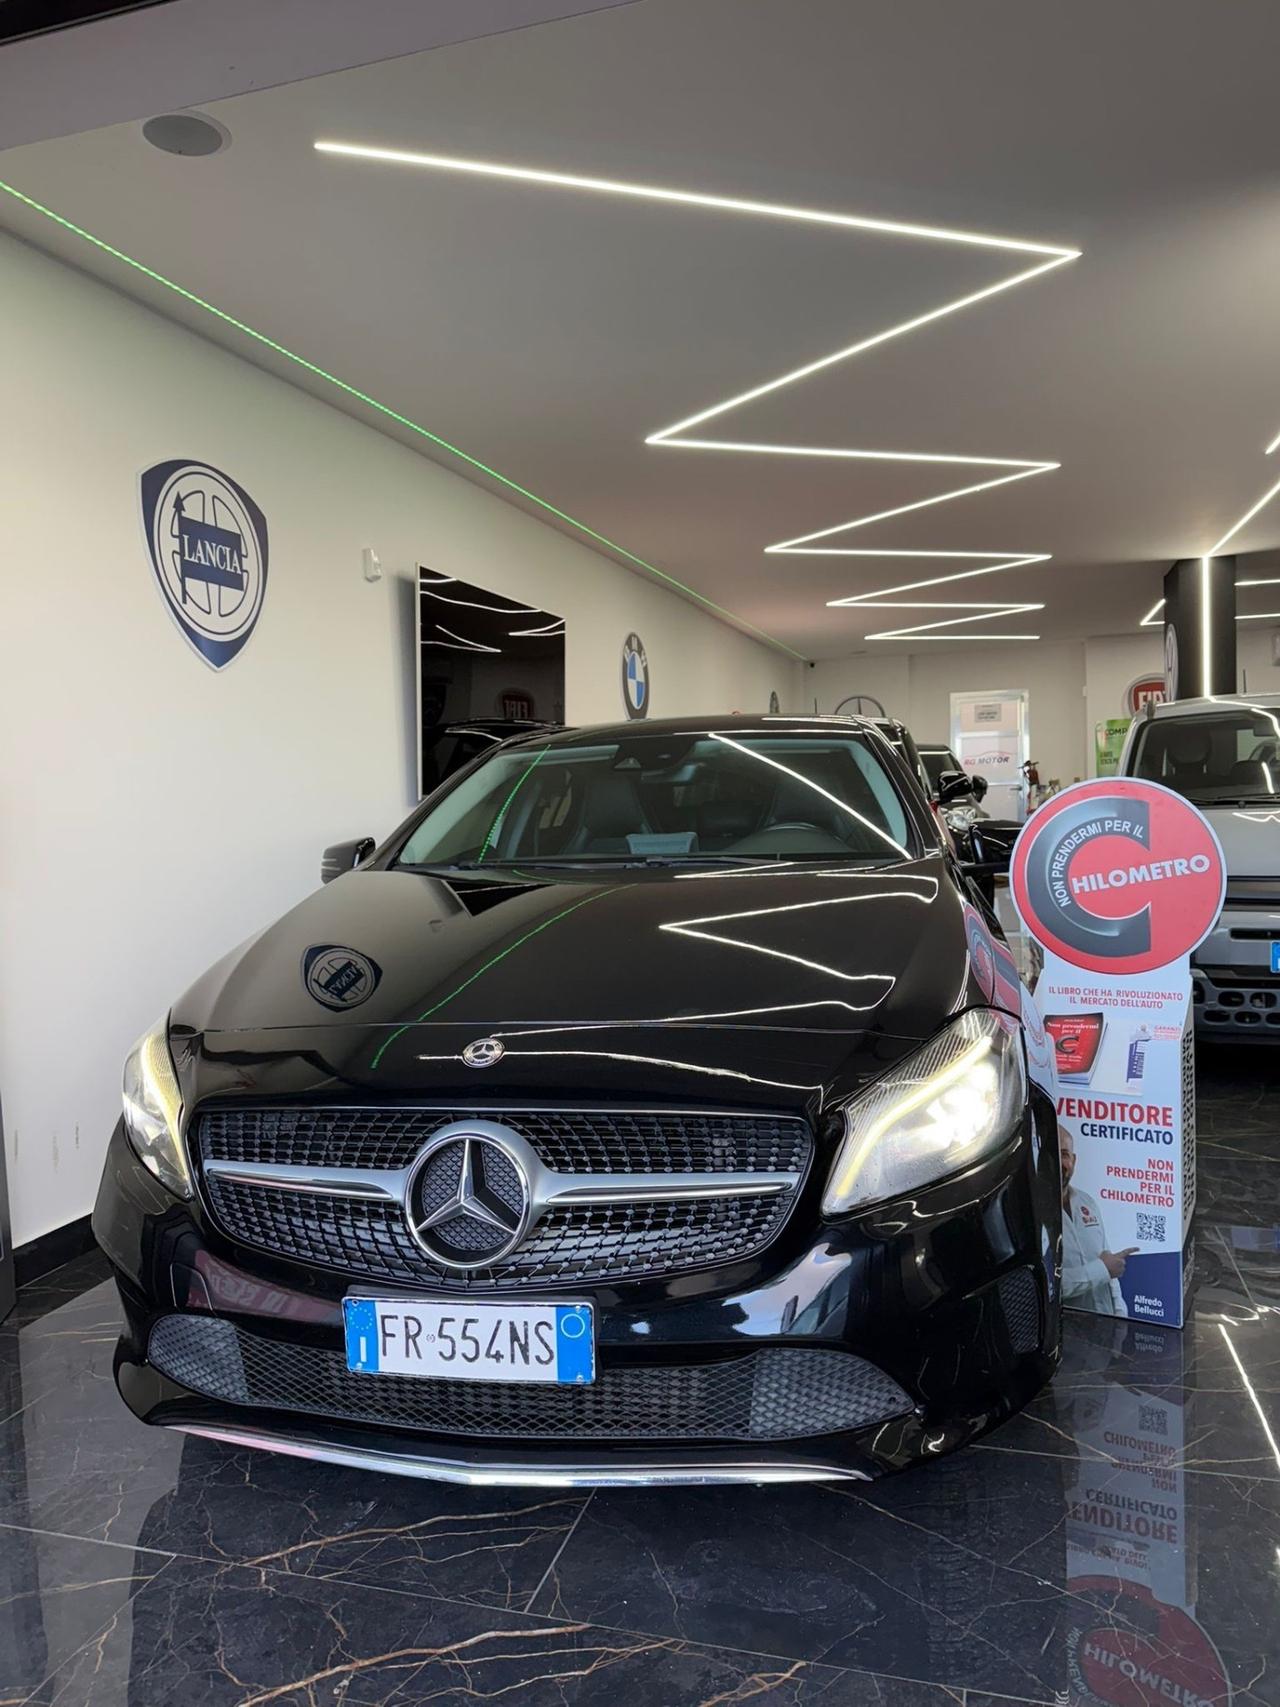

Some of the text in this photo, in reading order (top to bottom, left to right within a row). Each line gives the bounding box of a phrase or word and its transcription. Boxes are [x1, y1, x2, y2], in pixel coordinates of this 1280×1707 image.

[182, 533, 241, 575] LANCIA
[1138, 691, 1167, 711] FIA
[978, 756, 1010, 765] MOTOR
[1052, 820, 1144, 908] NON PRENDERMI PER IL
[1048, 986, 1183, 1001] IL LIBRO CHE HA RIVOLUZIONATO
[1069, 996, 1163, 1009] IL MERCATO DELL'AUTO
[1080, 1122, 1173, 1145] CERTIFICATO
[1147, 1158, 1174, 1171] NON
[1106, 1165, 1174, 1183] PRENDERMI
[1140, 1181, 1175, 1196] PER IL
[1100, 1188, 1174, 1208] CHILOMETRO
[1134, 1295, 1163, 1307] Alfredo
[1134, 1304, 1165, 1317] Bellucci
